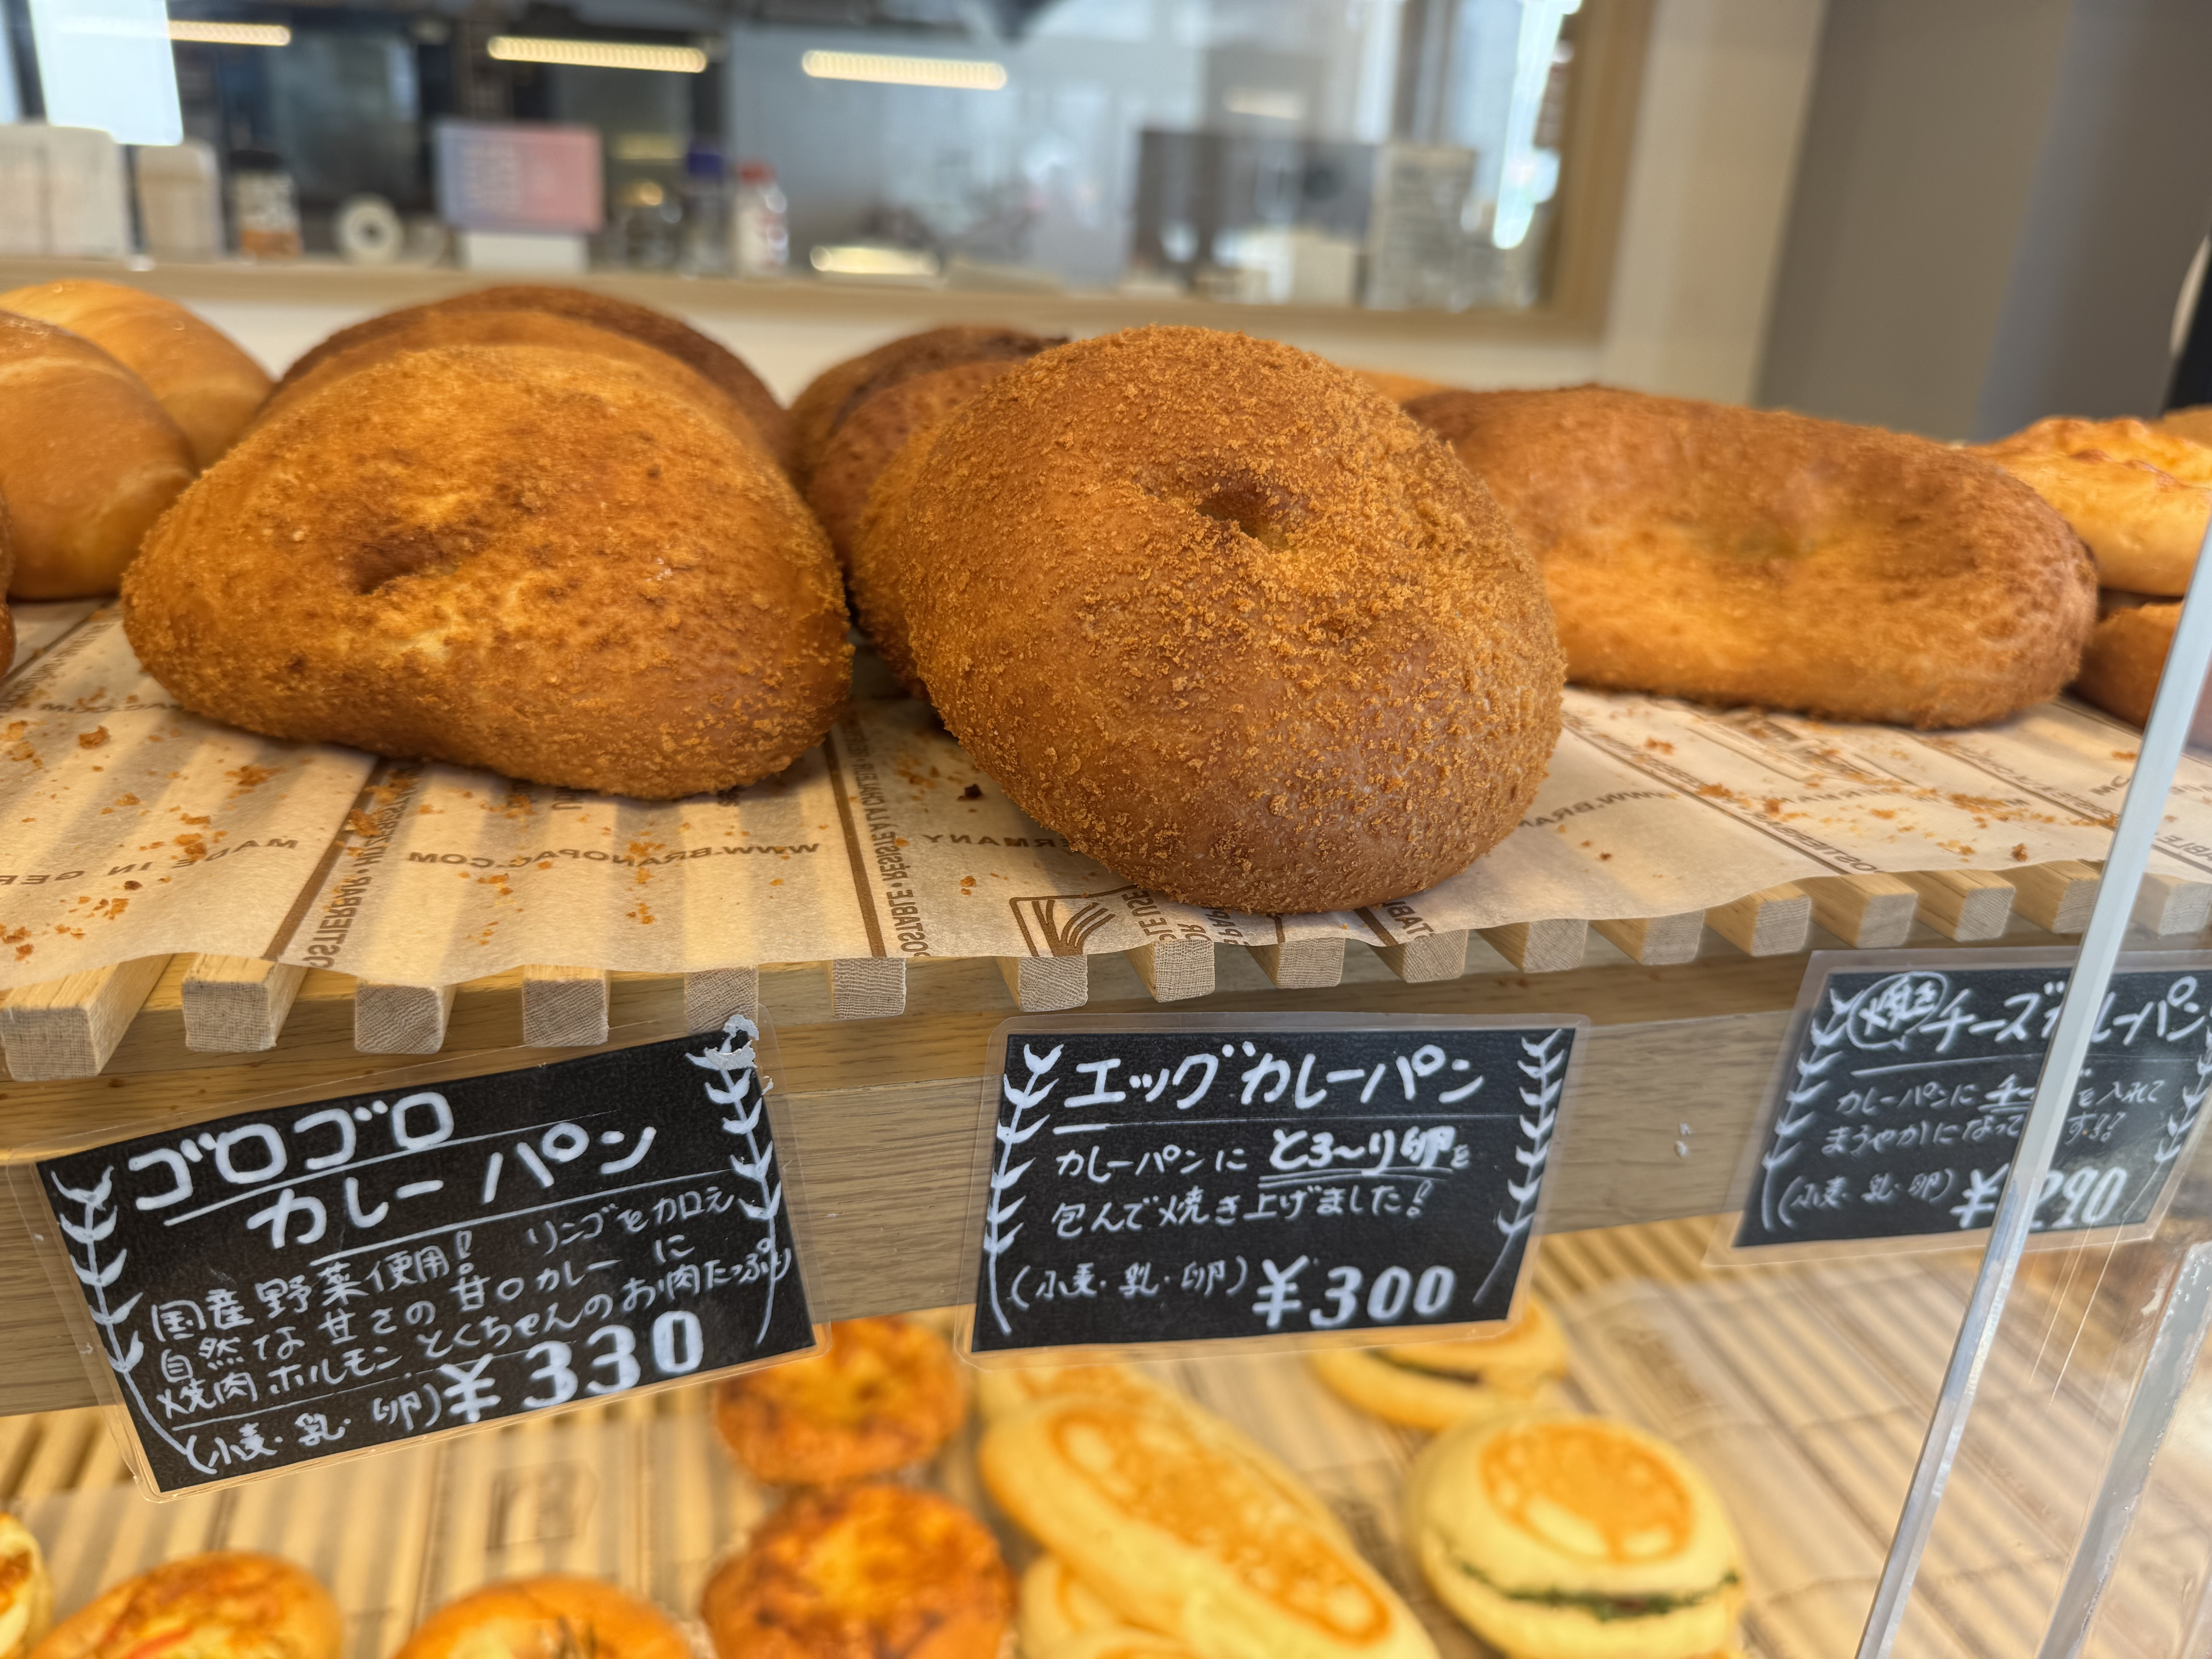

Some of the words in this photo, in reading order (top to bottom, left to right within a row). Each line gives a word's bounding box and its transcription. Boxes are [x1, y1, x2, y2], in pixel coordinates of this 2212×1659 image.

[129, 1091, 455, 1211] ゴロゴロ
[246, 1122, 657, 1249] カレーパン
[1252, 1255, 1457, 1330] ¥300
[439, 1310, 704, 1422] ¥330
